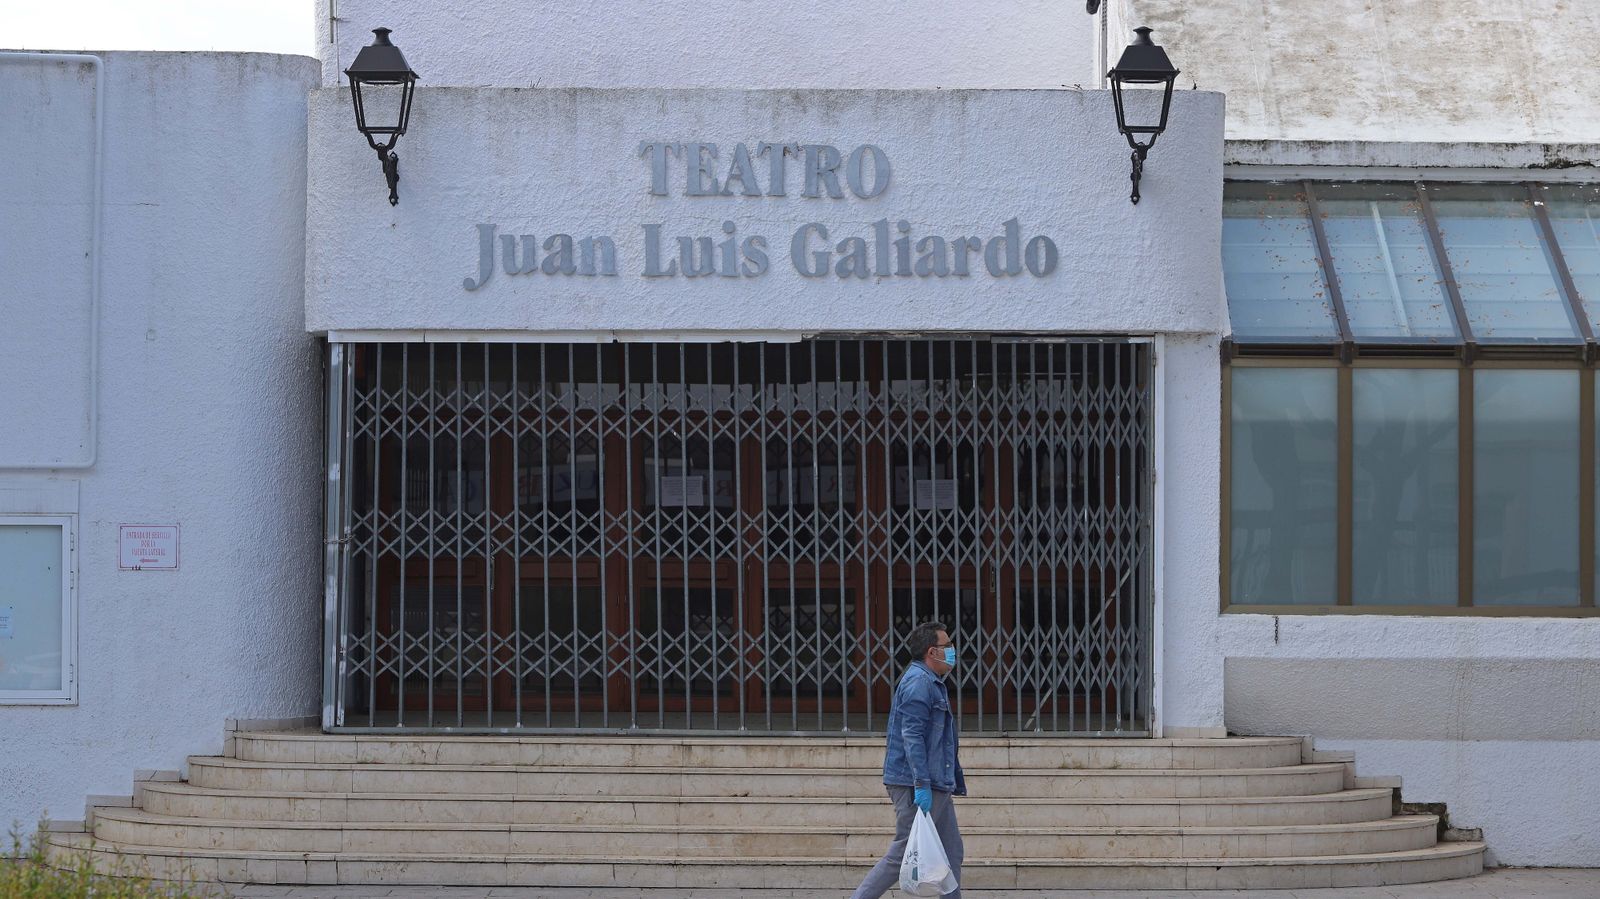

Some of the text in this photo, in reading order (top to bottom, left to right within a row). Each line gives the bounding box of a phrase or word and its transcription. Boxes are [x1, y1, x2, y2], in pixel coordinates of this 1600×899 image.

[641, 141, 891, 200] TEATRO
[463, 219, 1059, 292] Juan Luis Galiardo
